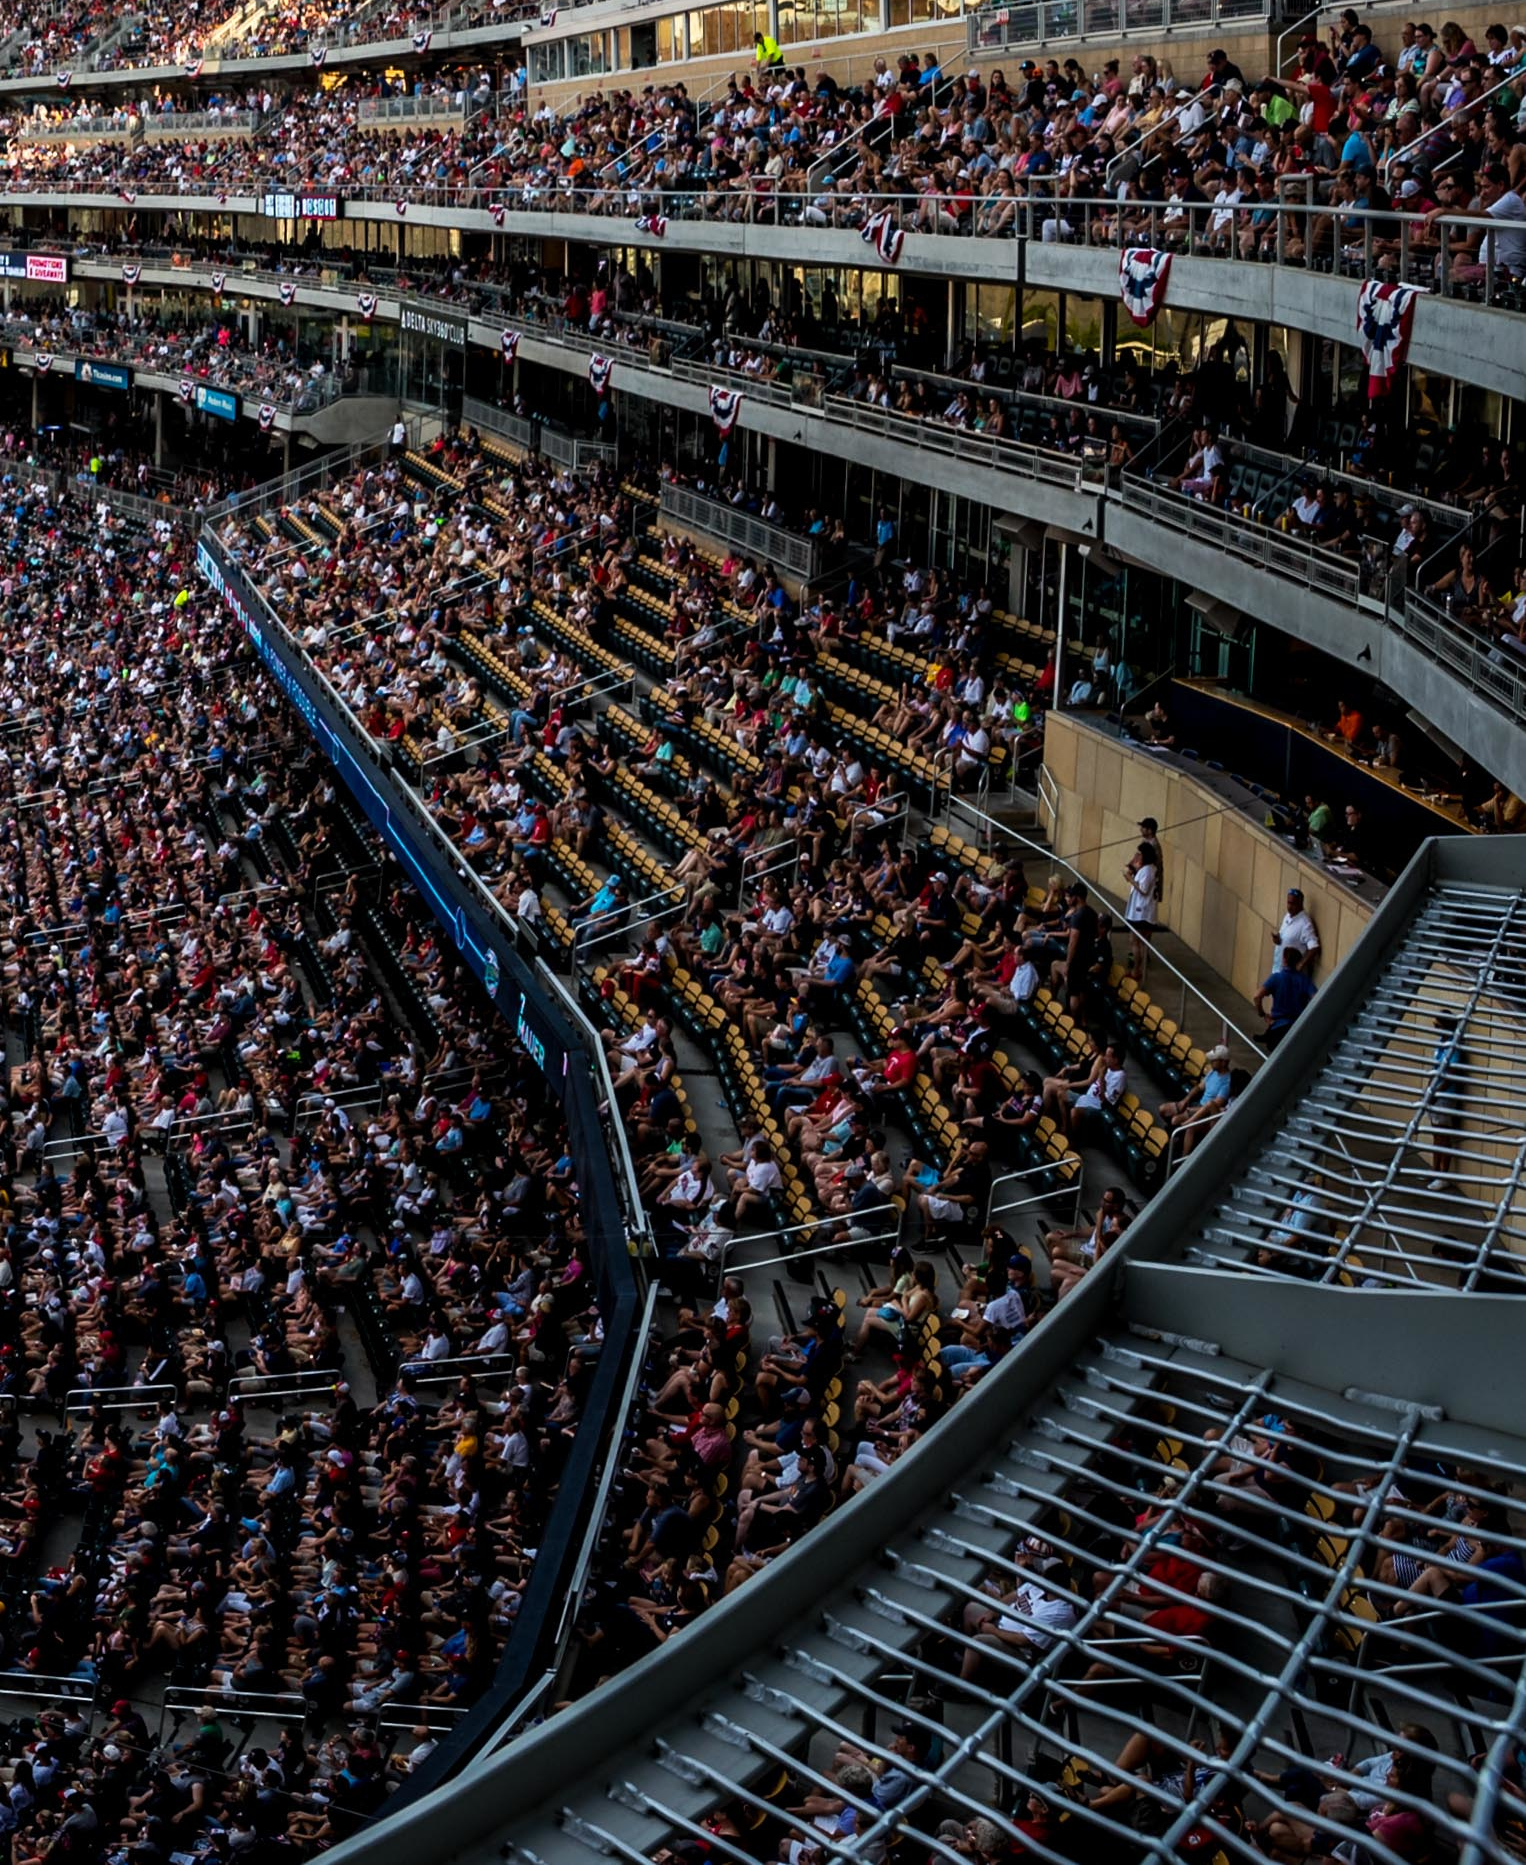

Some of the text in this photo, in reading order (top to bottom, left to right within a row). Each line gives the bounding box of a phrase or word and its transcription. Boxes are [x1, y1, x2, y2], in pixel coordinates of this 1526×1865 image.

[29, 258, 63, 269] PROMOTIONS
[35, 270, 64, 280] GIVEAWAYS
[407, 310, 425, 332] DELTA
[517, 1015, 545, 1071] MAUER
